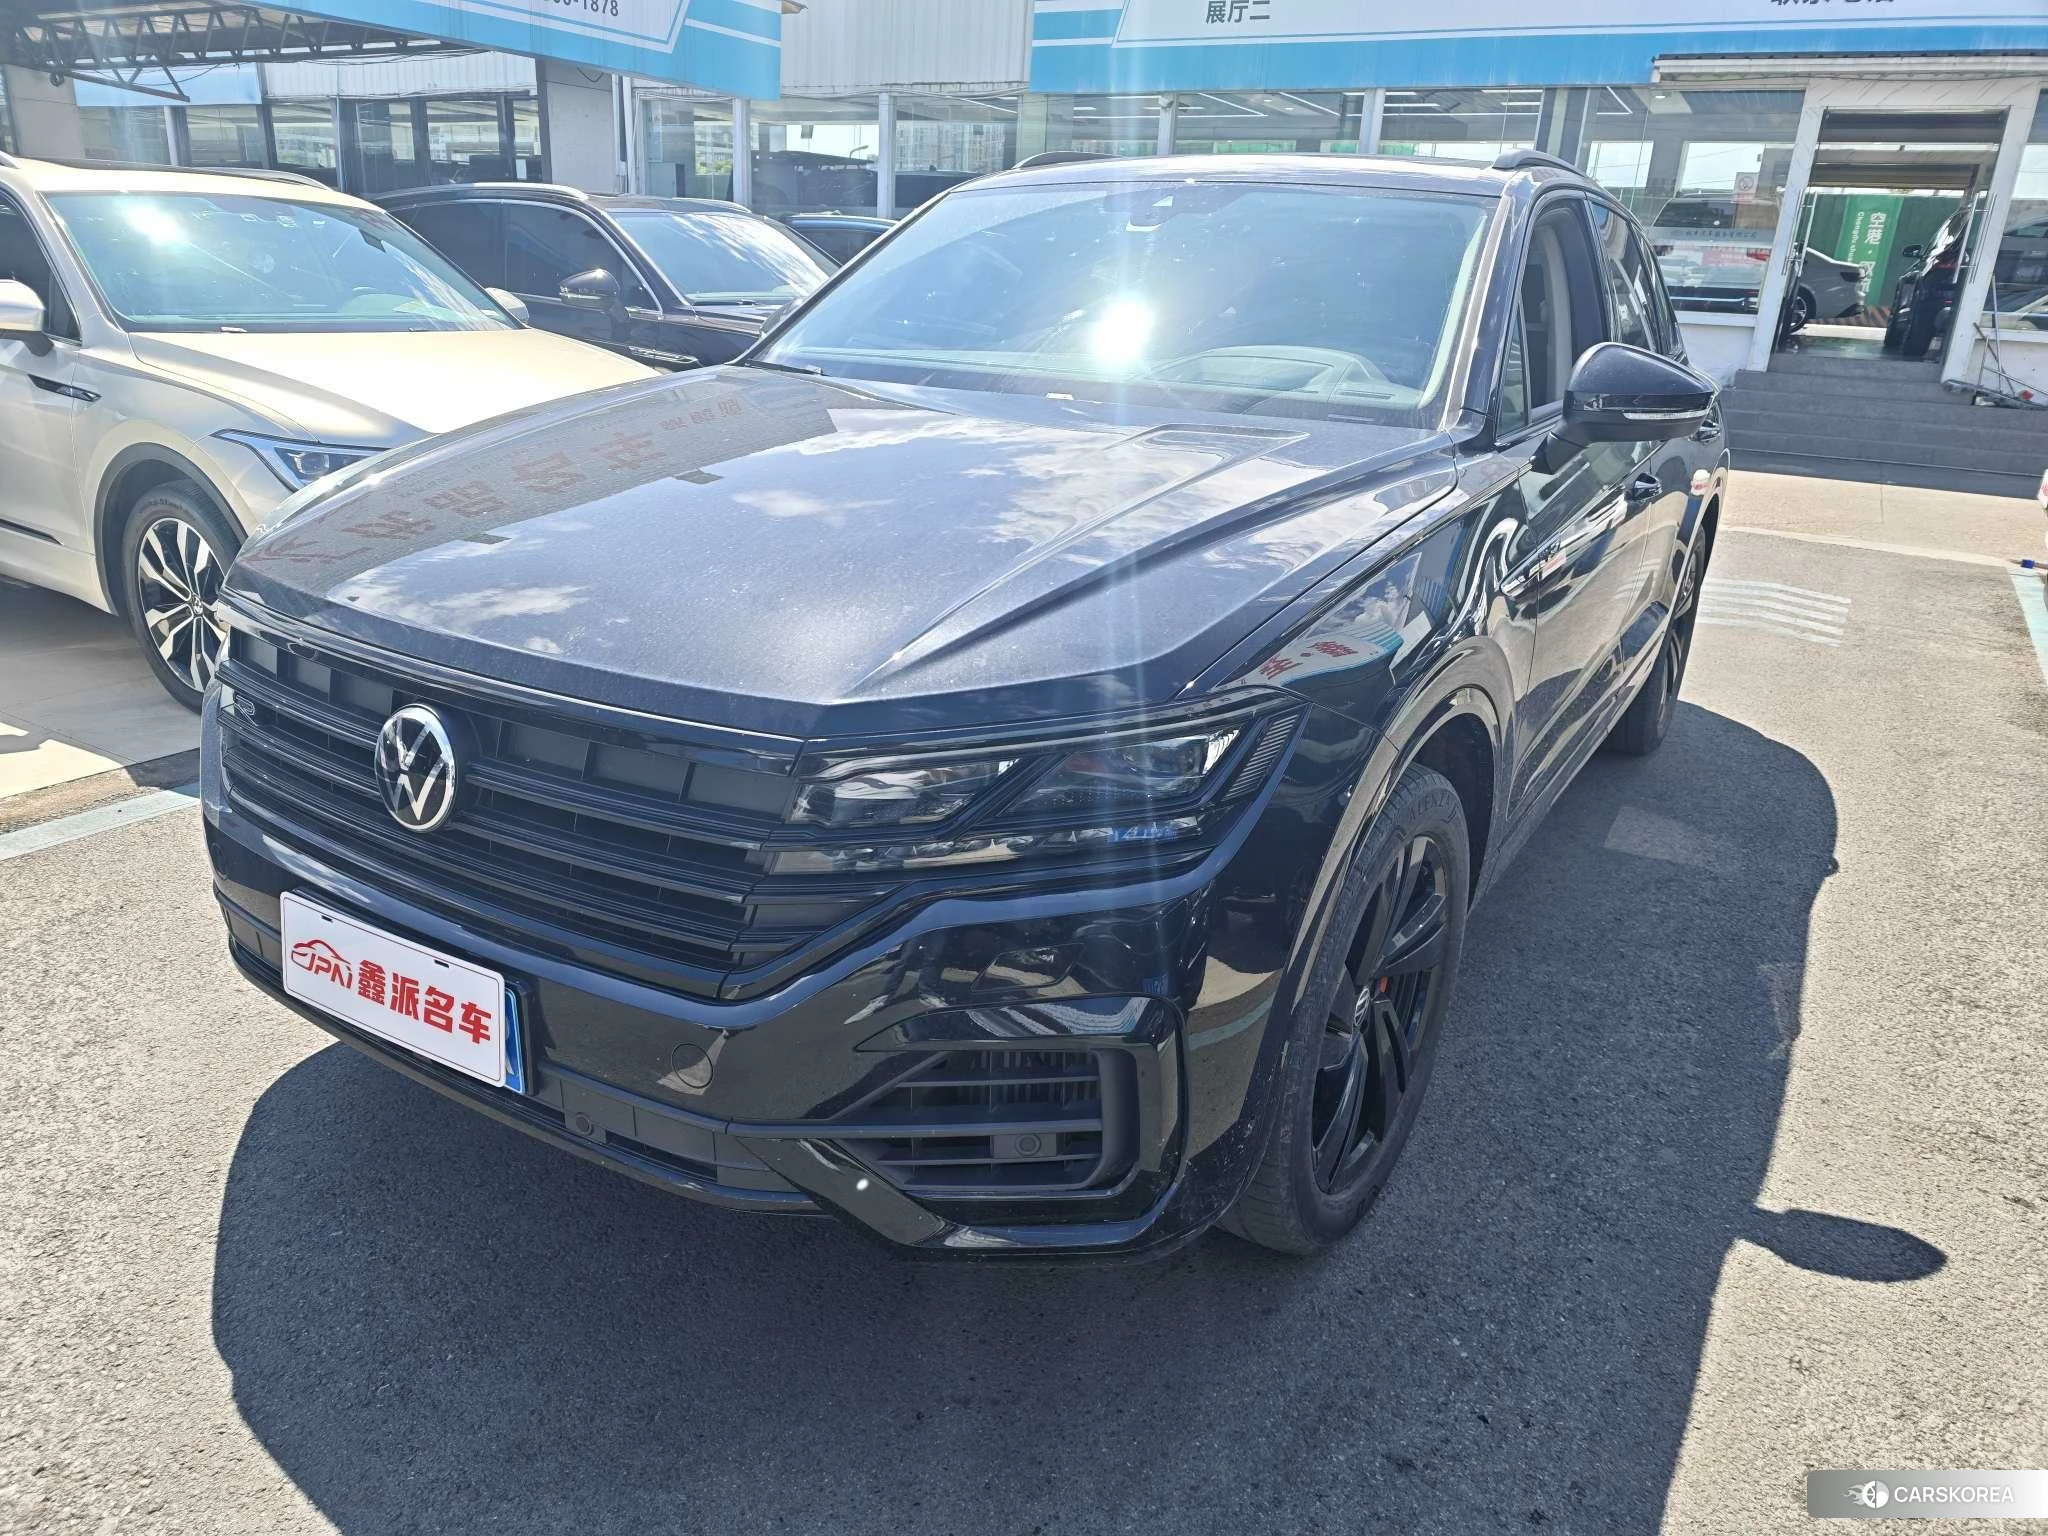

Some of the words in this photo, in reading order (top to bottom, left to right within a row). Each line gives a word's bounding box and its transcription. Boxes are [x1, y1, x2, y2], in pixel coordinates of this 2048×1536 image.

[553, 0, 618, 17] -1878
[1205, 0, 1270, 24] 展厅二
[358, 959, 492, 1044] 鑫派名车
